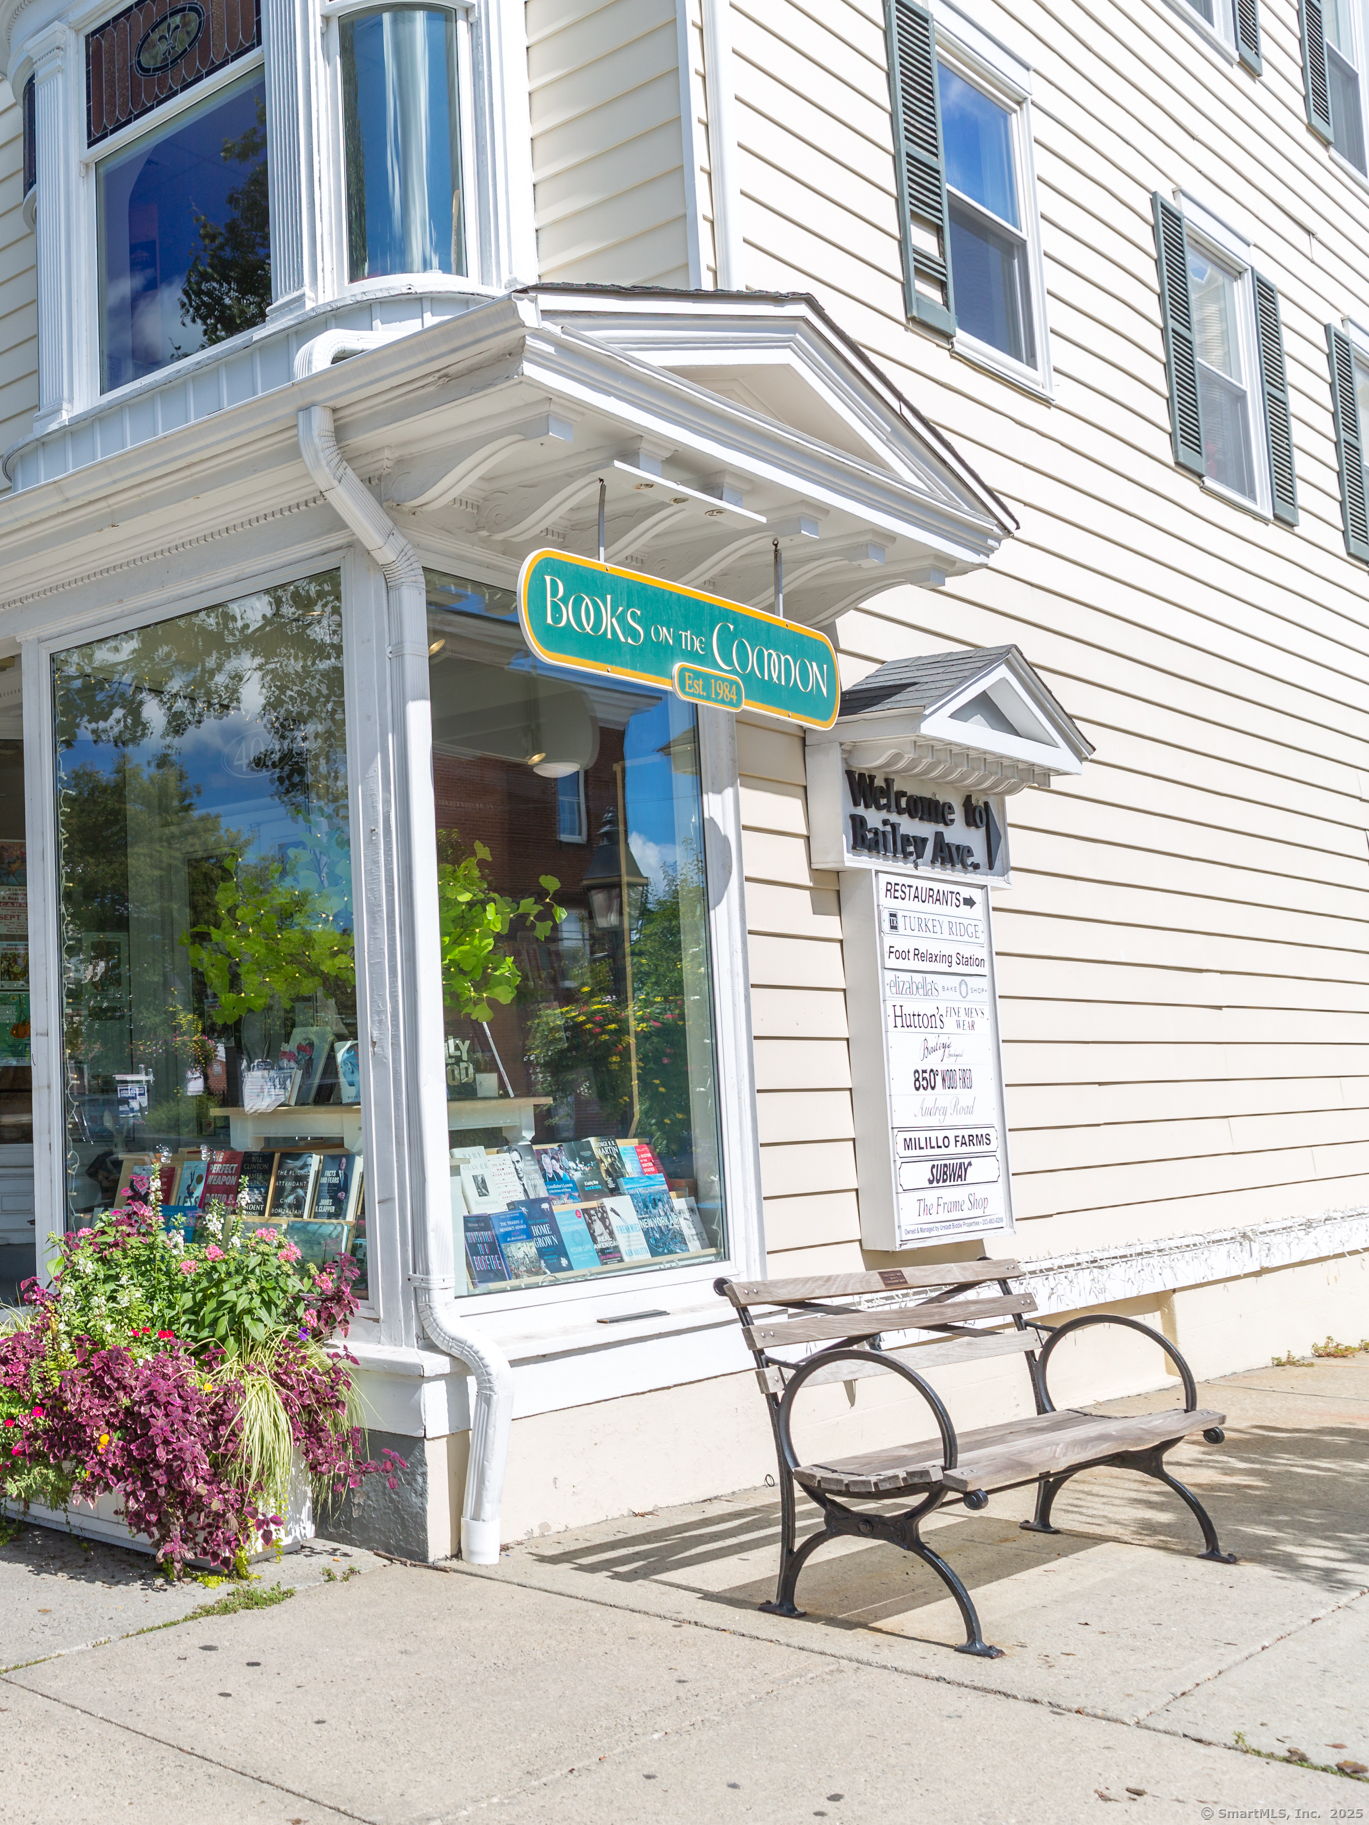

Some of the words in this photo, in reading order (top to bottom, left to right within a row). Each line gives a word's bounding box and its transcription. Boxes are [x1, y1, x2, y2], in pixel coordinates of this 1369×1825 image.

[684, 672, 707, 696] Est.
[710, 679, 737, 703] 1984
[845, 770, 955, 826] Welcome
[962, 794, 986, 828] to
[850, 814, 929, 869] Bailey
[931, 831, 980, 869] Ave.
[885, 882, 961, 908] RESTAURANTS
[902, 915, 944, 934] TURKEY
[948, 921, 980, 938] RIDGE
[888, 946, 910, 961] Foot
[913, 948, 952, 967] Relaxing
[956, 952, 985, 968] Station
[890, 974, 939, 997] elizabella's
[892, 1005, 944, 1029] Hutton's
[946, 1006, 961, 1018] FINE
[956, 1020, 975, 1031] WEAR
[914, 1069, 939, 1091] 850°
[941, 1069, 957, 1090] WOOD
[914, 1097, 948, 1124] Audrey
[950, 1096, 976, 1116] Road
[595, 1146, 619, 1156] MARTIN
[903, 1136, 950, 1151] MILILLO
[954, 1133, 991, 1148] FARMS
[207, 1175, 237, 1186] WEAPON
[210, 1164, 238, 1174] PERFECT
[927, 1160, 972, 1185] SUBWAY
[917, 1198, 933, 1217] The
[937, 1197, 965, 1214] Frame
[968, 1193, 988, 1214] Shop
[531, 1224, 552, 1237] HOME
[533, 1235, 558, 1248] GROWN
